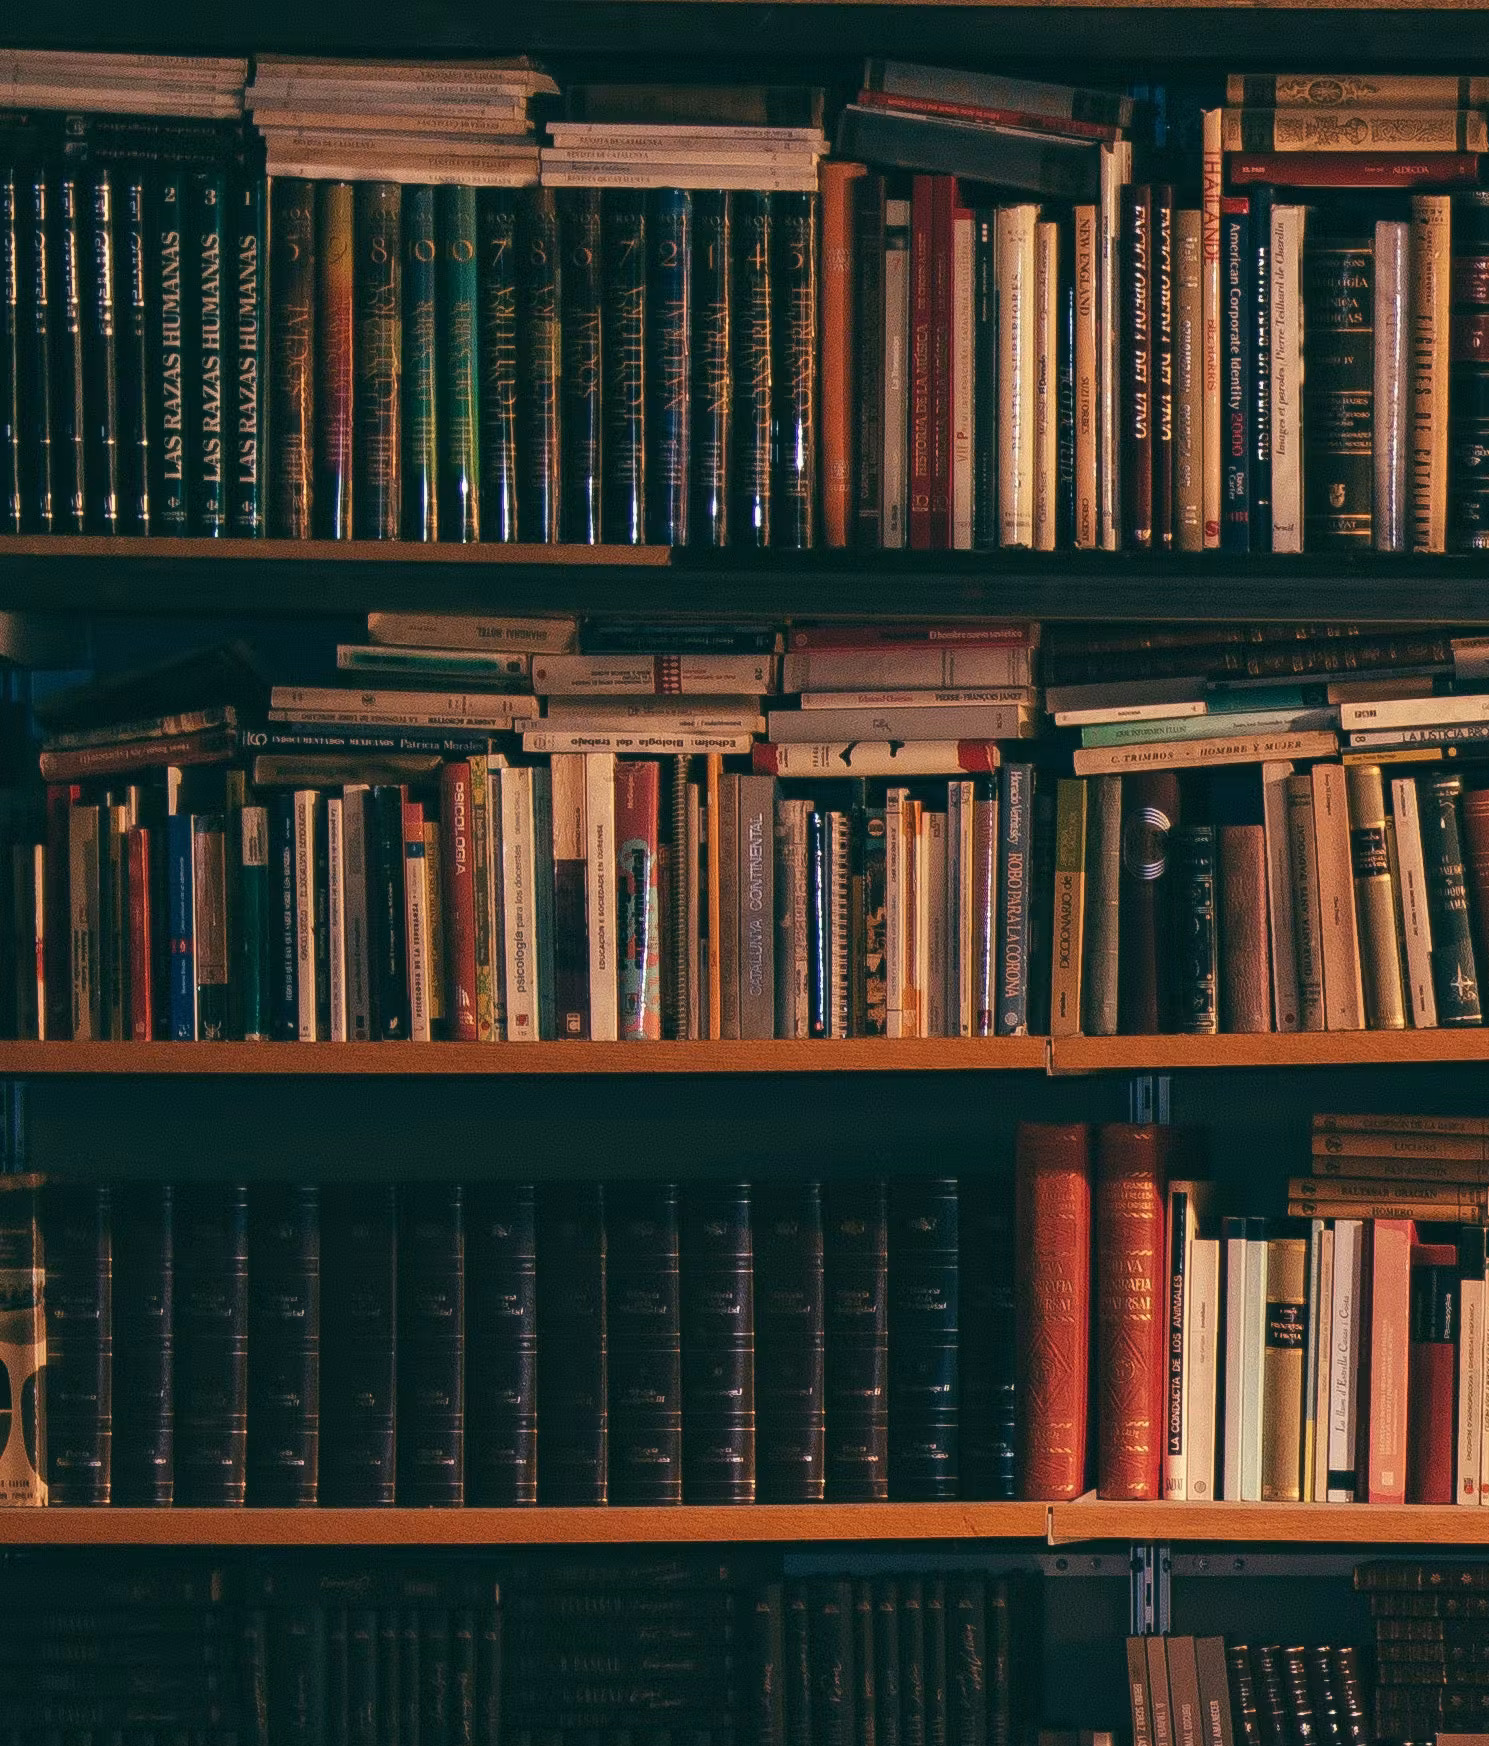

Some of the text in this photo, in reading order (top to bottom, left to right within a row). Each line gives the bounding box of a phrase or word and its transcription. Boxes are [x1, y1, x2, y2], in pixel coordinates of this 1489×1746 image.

[1079, 218, 1091, 317] NEW ENGLAND
[1229, 223, 1241, 284] American
[1227, 288, 1241, 354] Corporate
[161, 232, 182, 480] LAS RAZAS HUMANAS
[201, 233, 221, 483] LAS RAZAS HUMANAS
[1228, 358, 1242, 410] Identity
[749, 813, 763, 996] CATALUNYA CONTINENTAL
[1005, 853, 1023, 997] ROBO PARA LA CORONA
[1171, 1358, 1181, 1372] DE
[1172, 1332, 1182, 1353] LOS
[1170, 1377, 1180, 1433] CONDUCTA
[1171, 1437, 1179, 1451] LA
